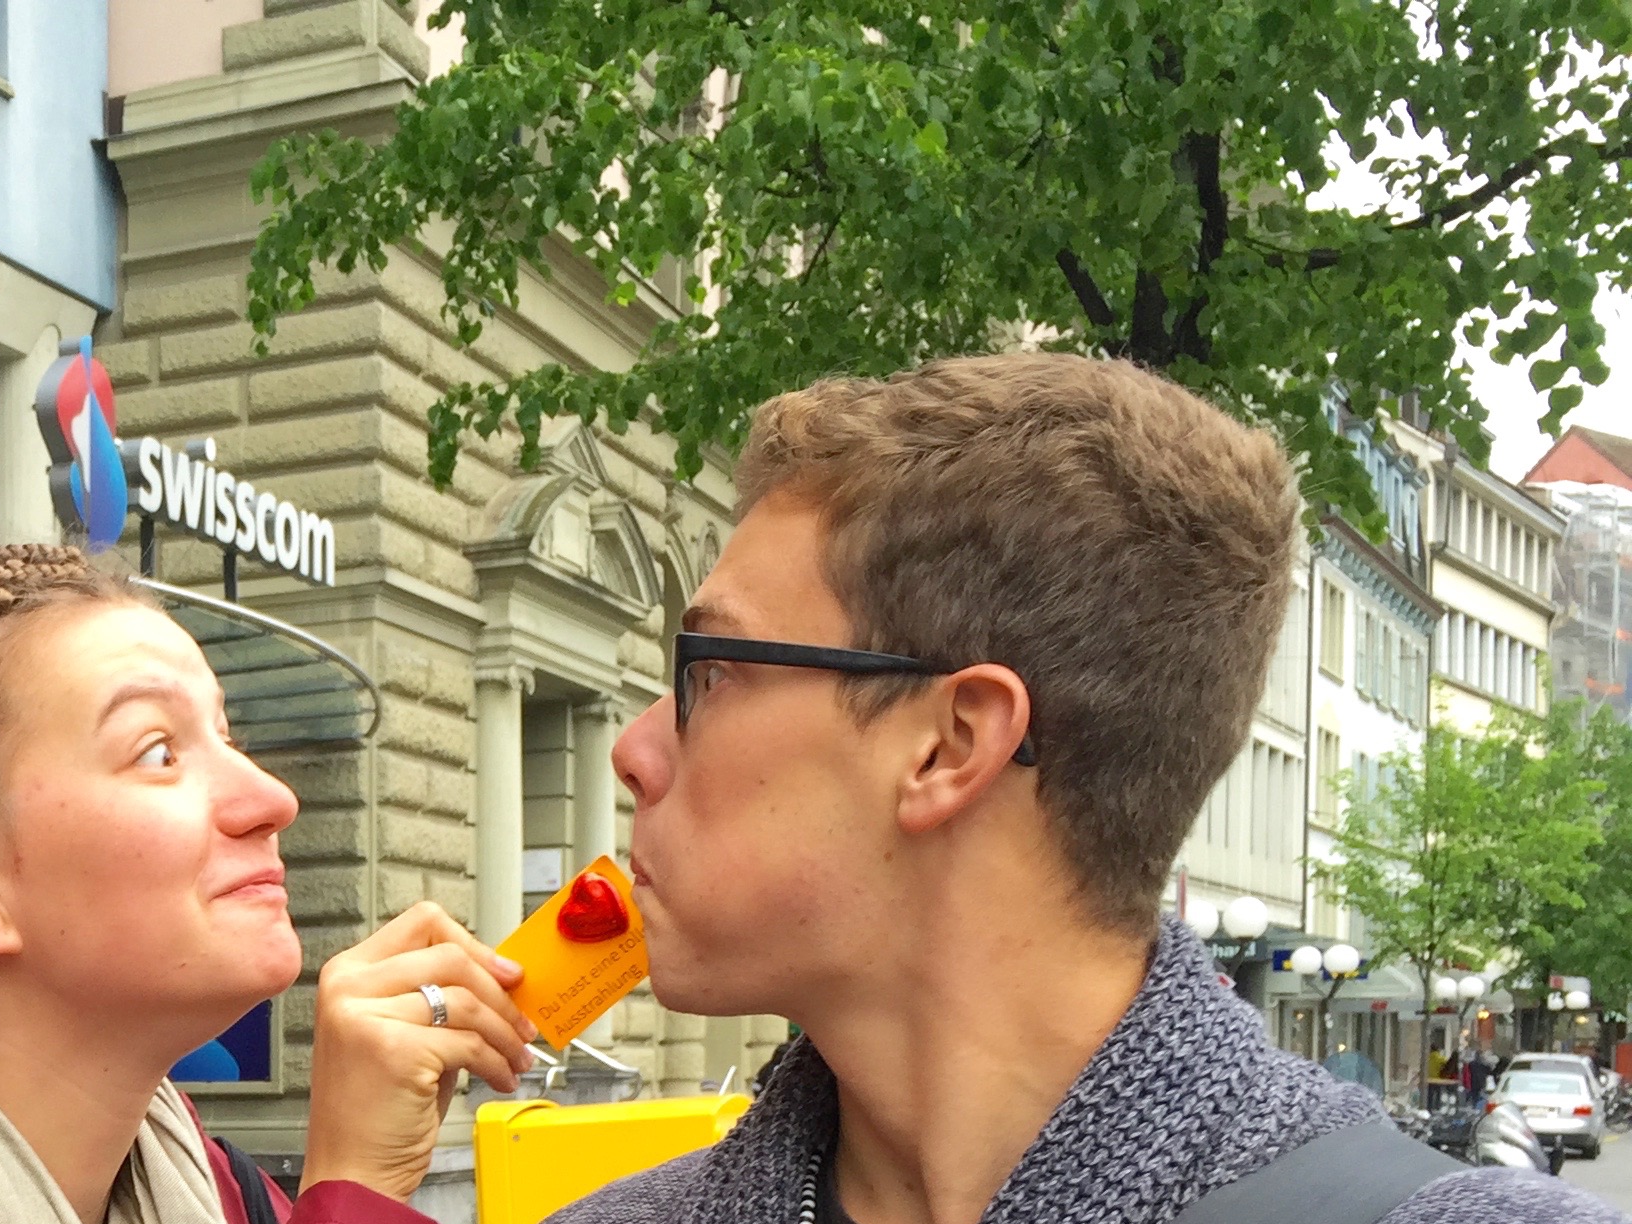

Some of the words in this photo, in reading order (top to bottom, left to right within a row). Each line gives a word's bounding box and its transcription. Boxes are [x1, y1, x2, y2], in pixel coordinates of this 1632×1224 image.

[138, 436, 335, 587] swisscom
[538, 1001, 561, 1021] Du
[556, 974, 592, 1001] hast
[591, 951, 622, 979] eine
[618, 927, 645, 954] toll
[555, 964, 643, 1036] Ausstrahlung
